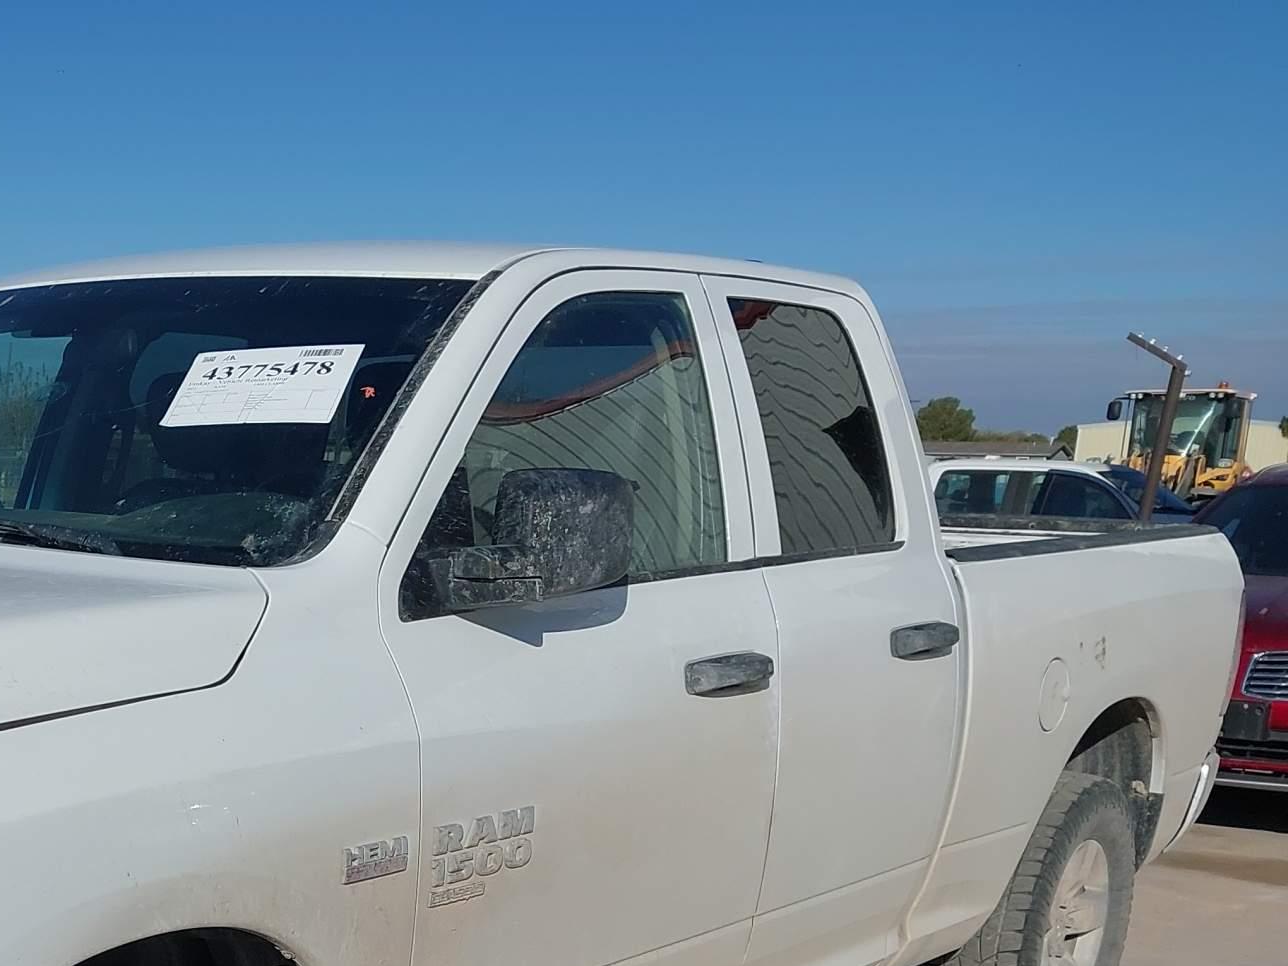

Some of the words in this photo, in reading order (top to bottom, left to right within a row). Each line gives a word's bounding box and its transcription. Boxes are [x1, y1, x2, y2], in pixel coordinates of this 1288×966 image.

[202, 360, 335, 381] 43775478
[343, 835, 409, 868] HEMI
[432, 805, 536, 857] RAM
[431, 837, 533, 889] 1500
